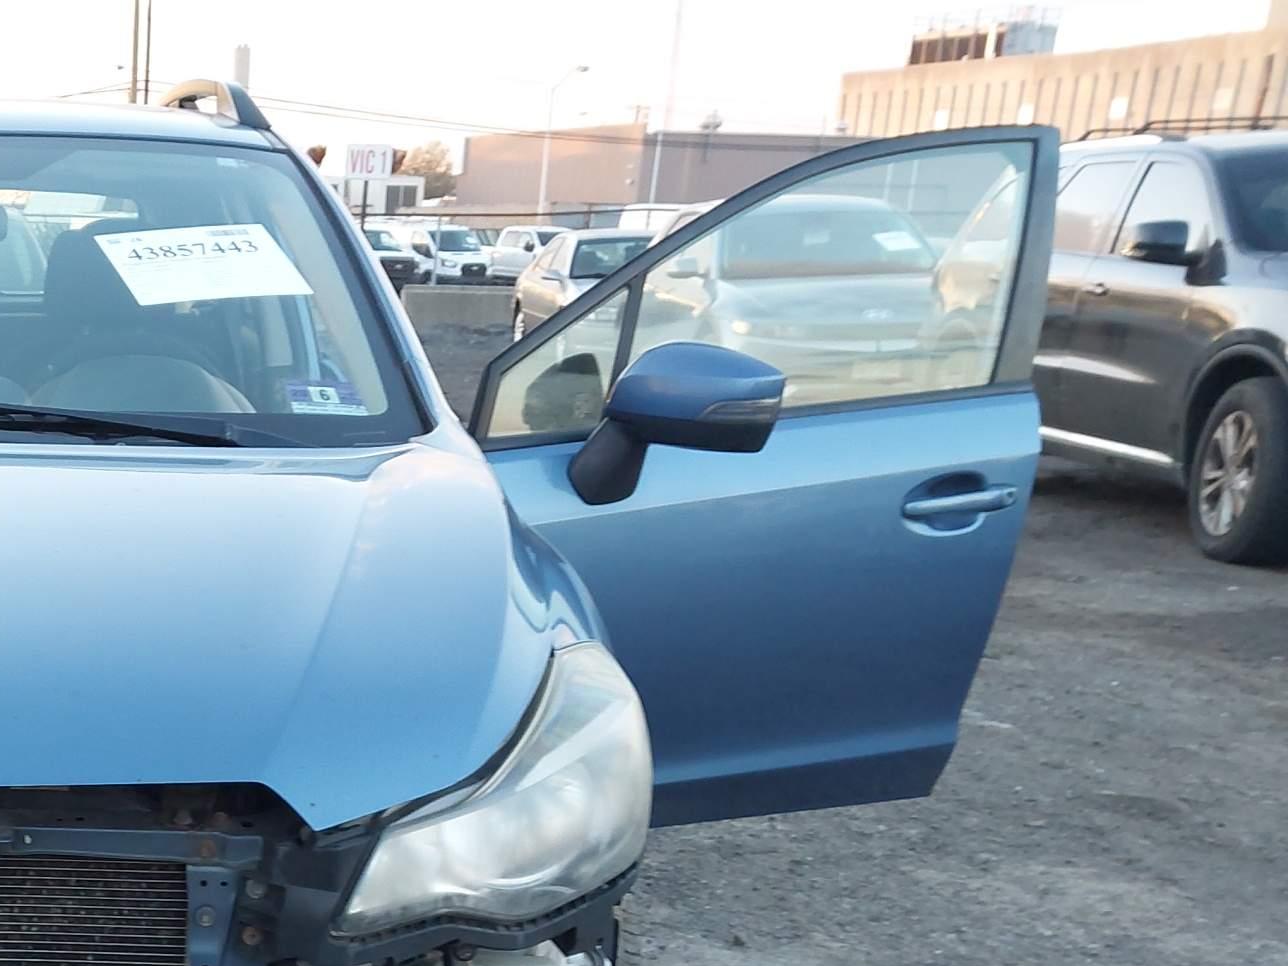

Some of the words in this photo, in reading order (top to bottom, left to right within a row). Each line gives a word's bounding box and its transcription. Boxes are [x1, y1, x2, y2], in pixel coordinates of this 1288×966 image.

[350, 149, 376, 174] VIC
[380, 149, 387, 174] 1
[127, 240, 259, 261] 43857443
[319, 389, 331, 401] 6
